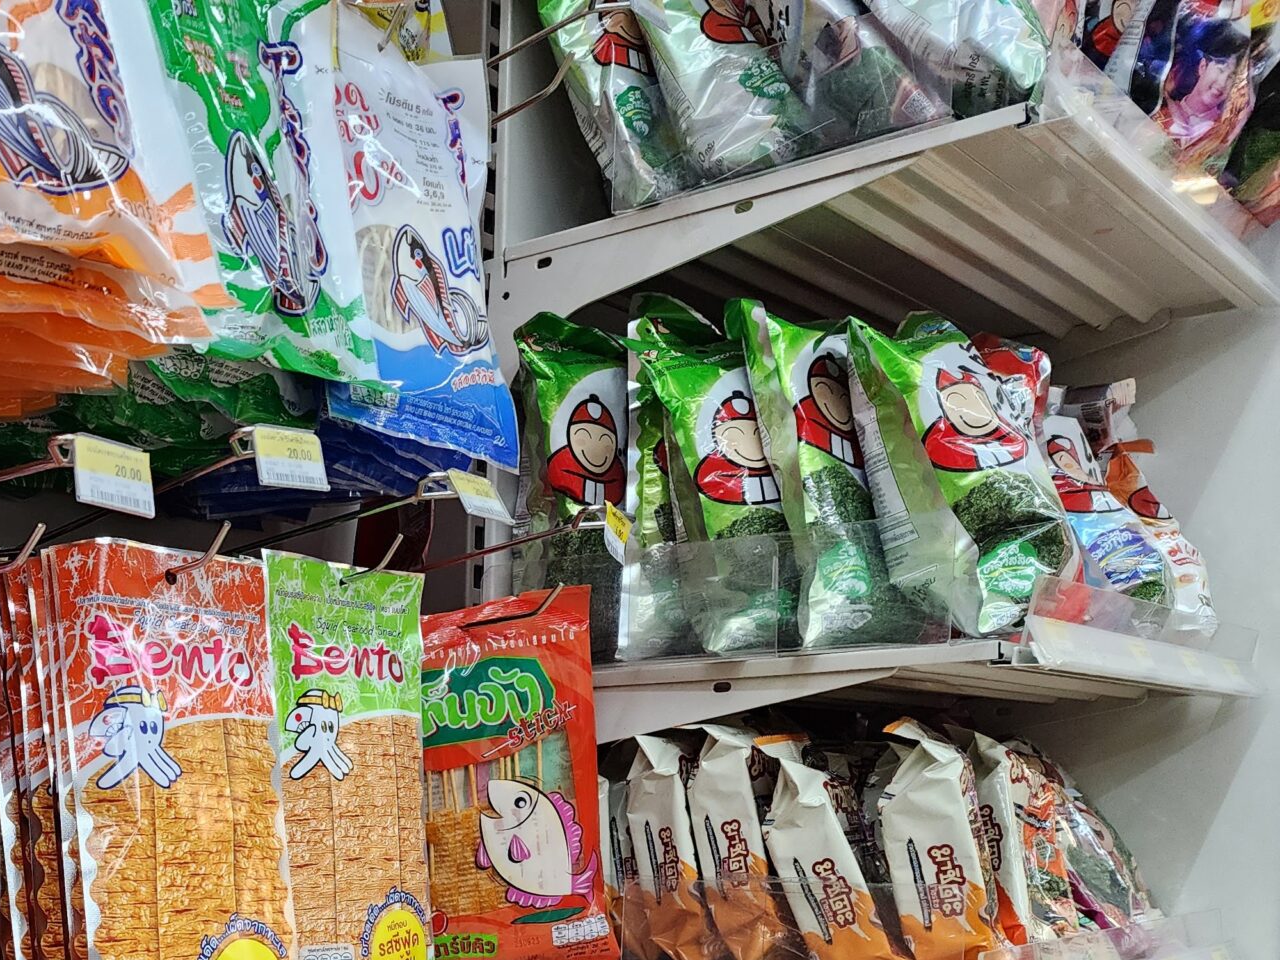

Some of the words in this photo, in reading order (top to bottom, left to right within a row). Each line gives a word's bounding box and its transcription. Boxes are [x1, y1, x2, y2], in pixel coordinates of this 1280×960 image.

[114, 463, 142, 482] 20.00
[287, 447, 312, 462] 20.00
[87, 612, 255, 688] Bento
[287, 621, 405, 686] Bento
[507, 698, 575, 750] stick
